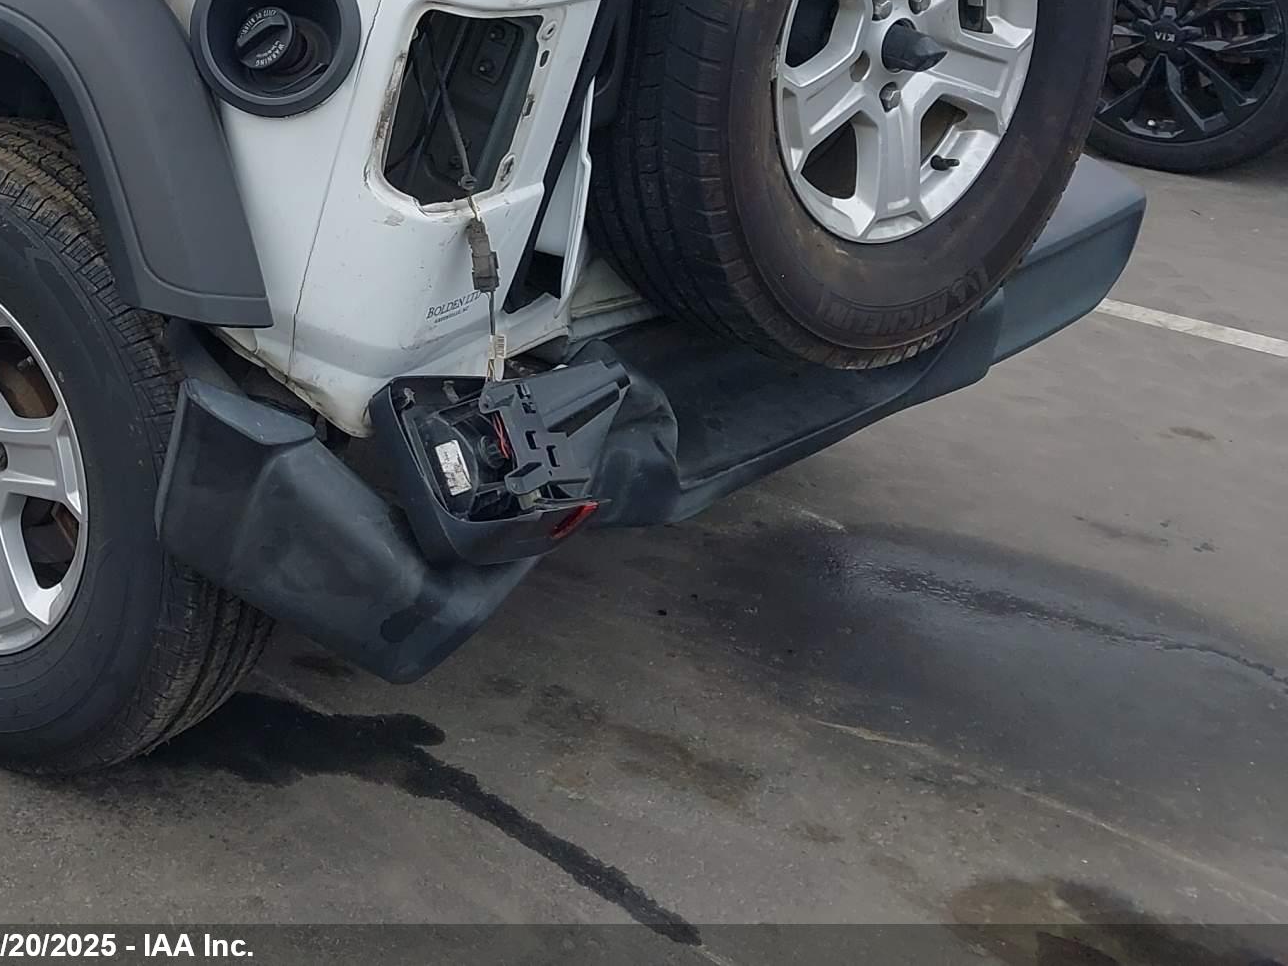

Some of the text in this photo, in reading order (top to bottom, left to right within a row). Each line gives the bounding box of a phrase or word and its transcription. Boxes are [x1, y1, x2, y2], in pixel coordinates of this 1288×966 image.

[1154, 31, 1176, 43] KIA
[255, 43, 285, 67] WARNING
[426, 295, 466, 320] BOLDEN
